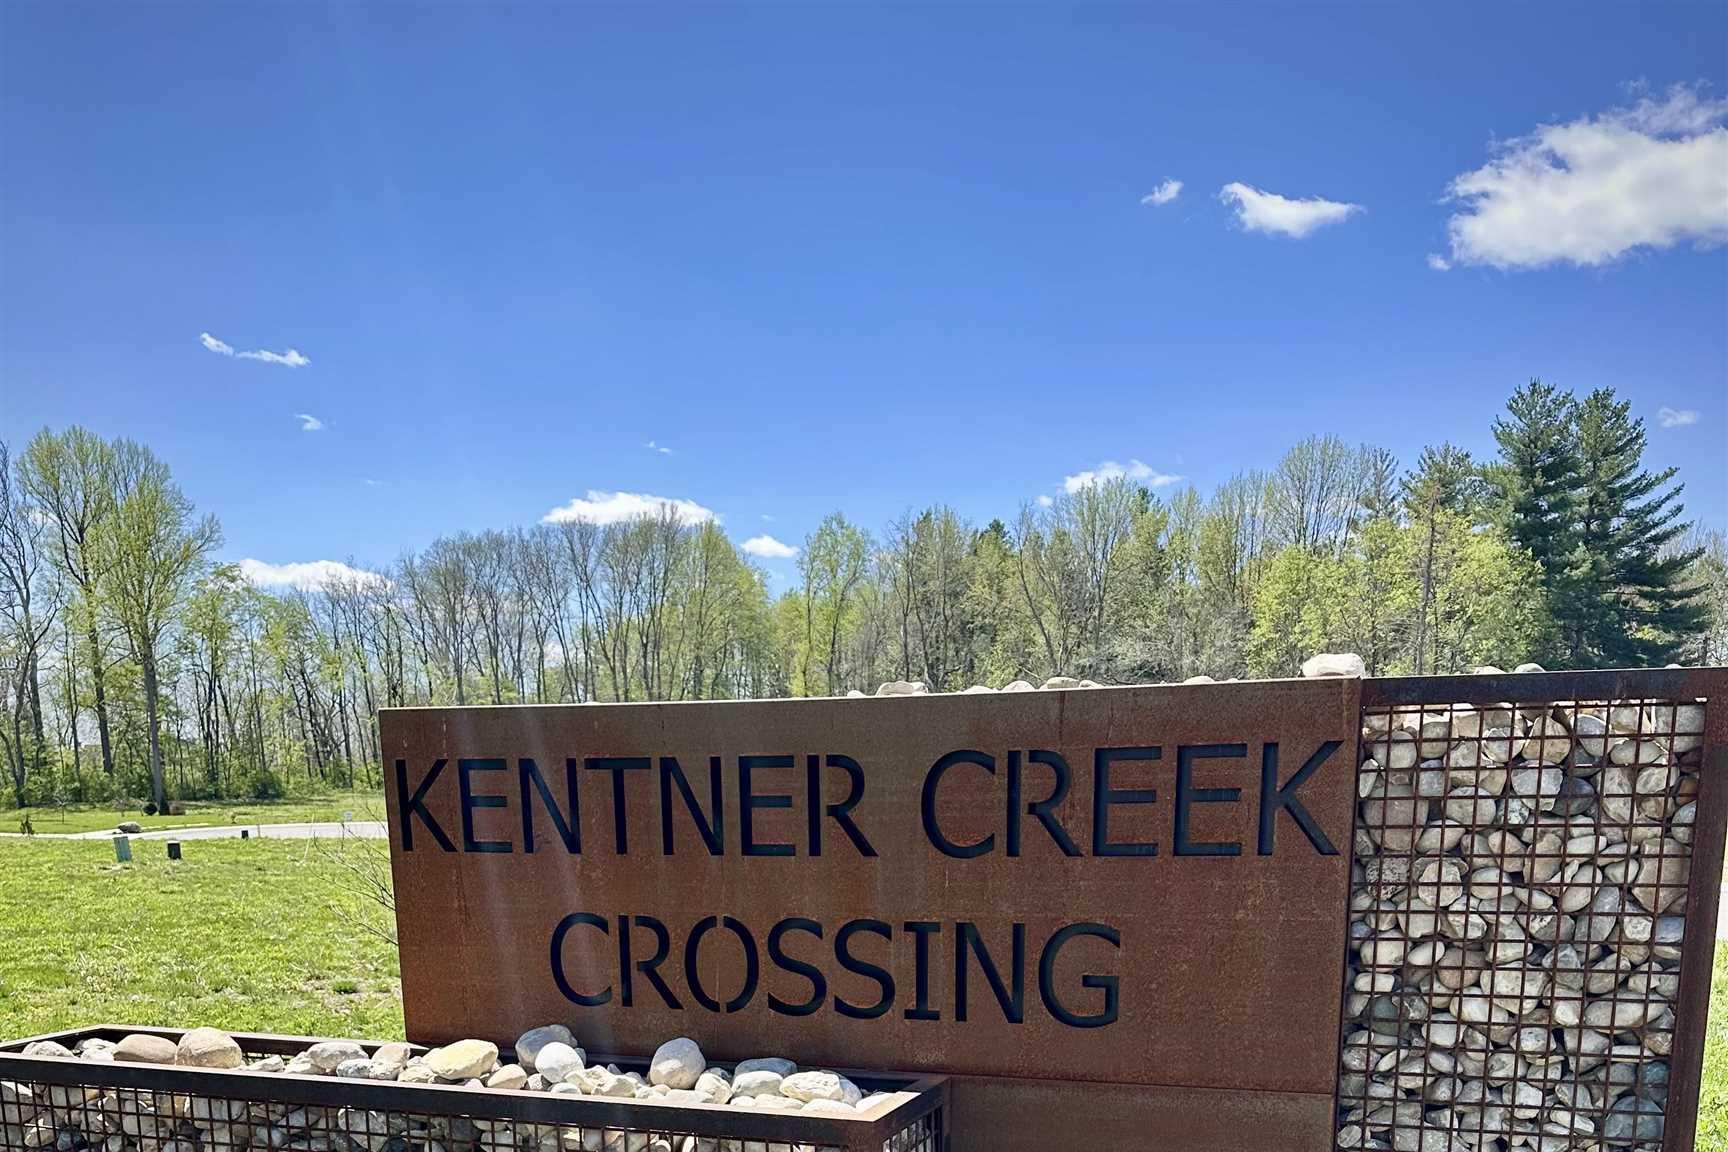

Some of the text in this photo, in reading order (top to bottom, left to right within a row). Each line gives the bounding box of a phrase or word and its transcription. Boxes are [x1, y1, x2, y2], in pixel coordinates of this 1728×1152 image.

[395, 740, 1344, 859] KENTNER CREEK
[550, 912, 1121, 1028] CROSSING
